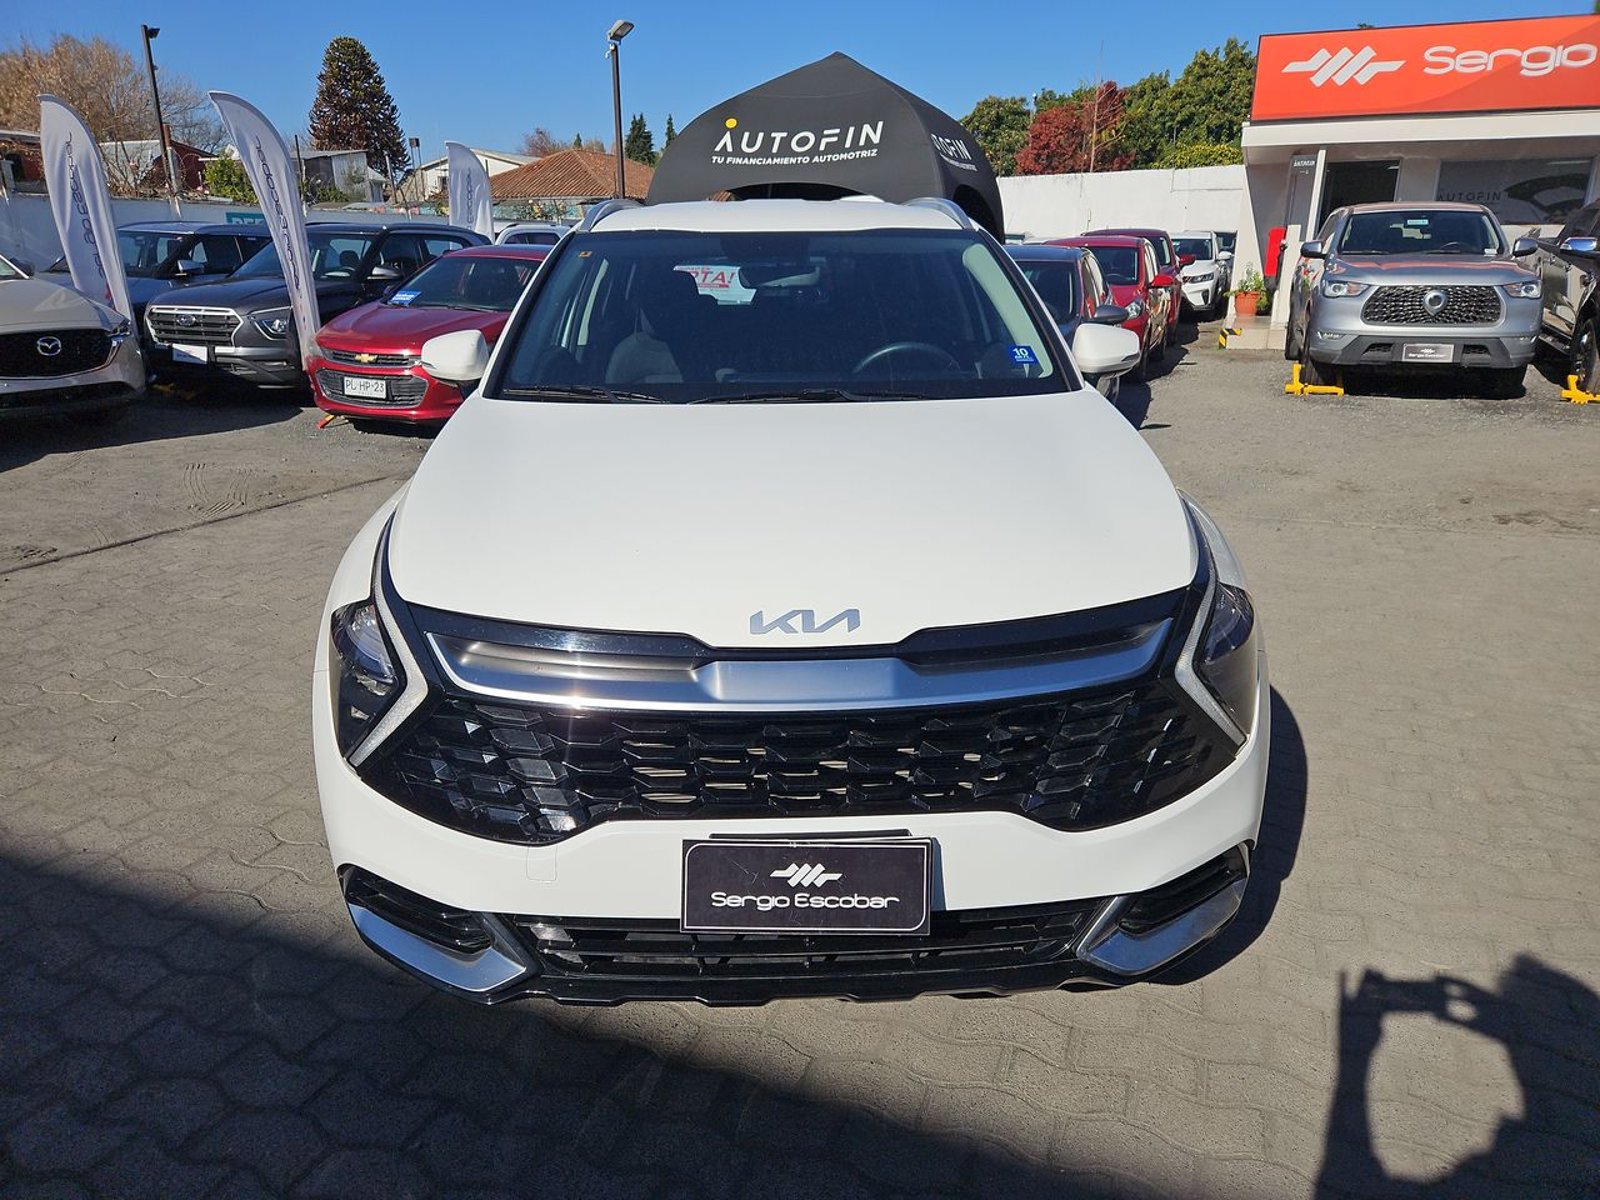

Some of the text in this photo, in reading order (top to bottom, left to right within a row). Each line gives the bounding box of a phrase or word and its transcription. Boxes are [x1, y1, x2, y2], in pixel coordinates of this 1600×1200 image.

[1424, 43, 1598, 77] Sergio
[714, 118, 884, 153] AUTOFIN
[711, 149, 878, 165] TU FINANCIAMIENTO AUTOMOTRIZ
[1012, 347, 1029, 356] 10
[750, 608, 861, 634] KIA
[711, 891, 900, 911] Sergio Escobar
